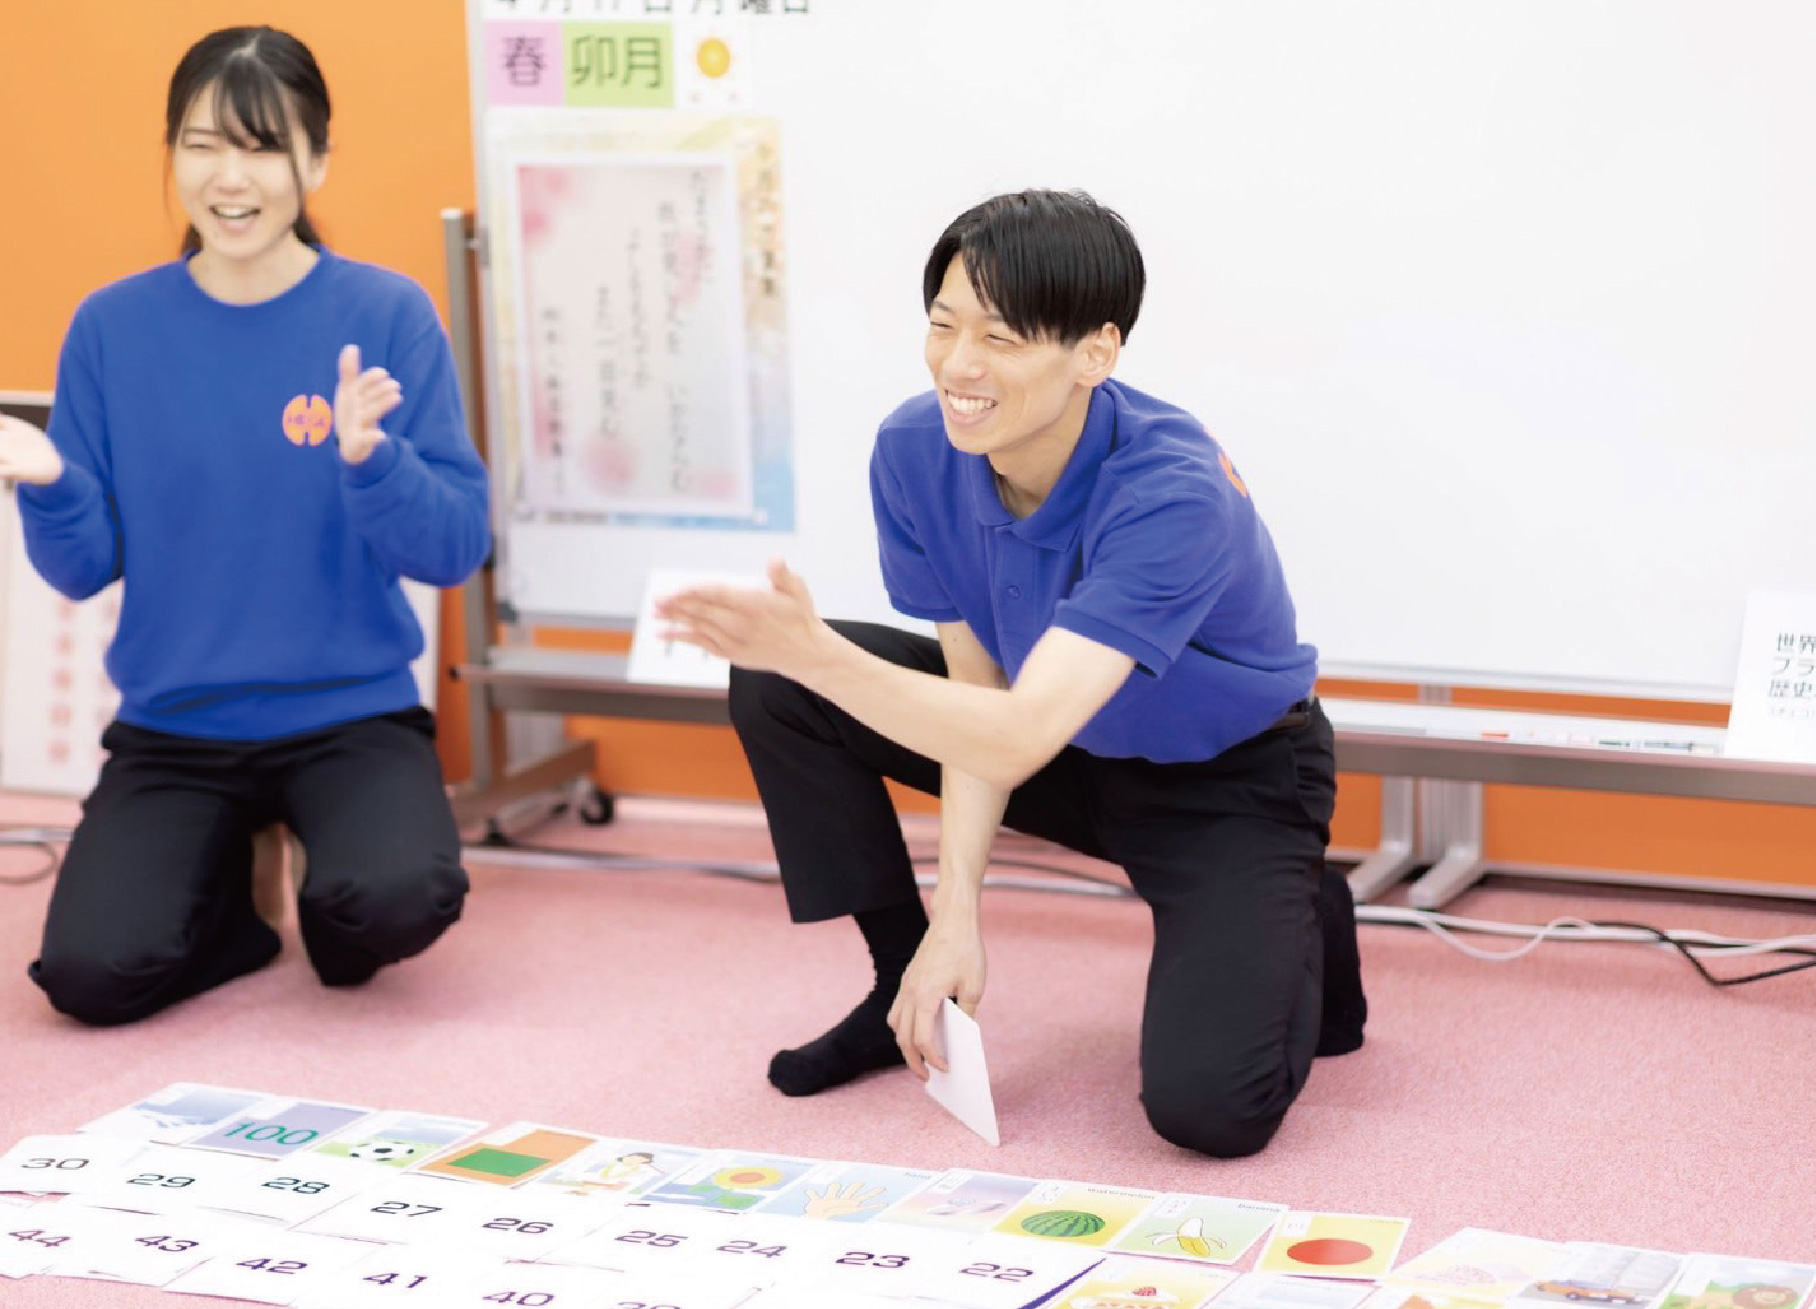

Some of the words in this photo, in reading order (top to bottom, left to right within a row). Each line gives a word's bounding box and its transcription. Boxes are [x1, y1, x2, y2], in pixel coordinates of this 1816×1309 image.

[501, 36, 549, 87] 春
[571, 35, 662, 89] 卯月
[227, 1121, 320, 1146] 100
[21, 1157, 90, 1171] 30
[126, 1172, 197, 1188] 29
[261, 1176, 331, 1195] 28
[370, 1201, 444, 1218] 27
[482, 1217, 555, 1234] 26
[8, 1228, 72, 1248] 44
[135, 1235, 200, 1253] 43
[614, 1230, 690, 1248] 25
[715, 1240, 788, 1259] 24
[235, 1257, 309, 1275] 42
[834, 1251, 911, 1269] 23
[363, 1272, 429, 1289] 41
[958, 1262, 1034, 1283] 22
[482, 1291, 555, 1307] 40
